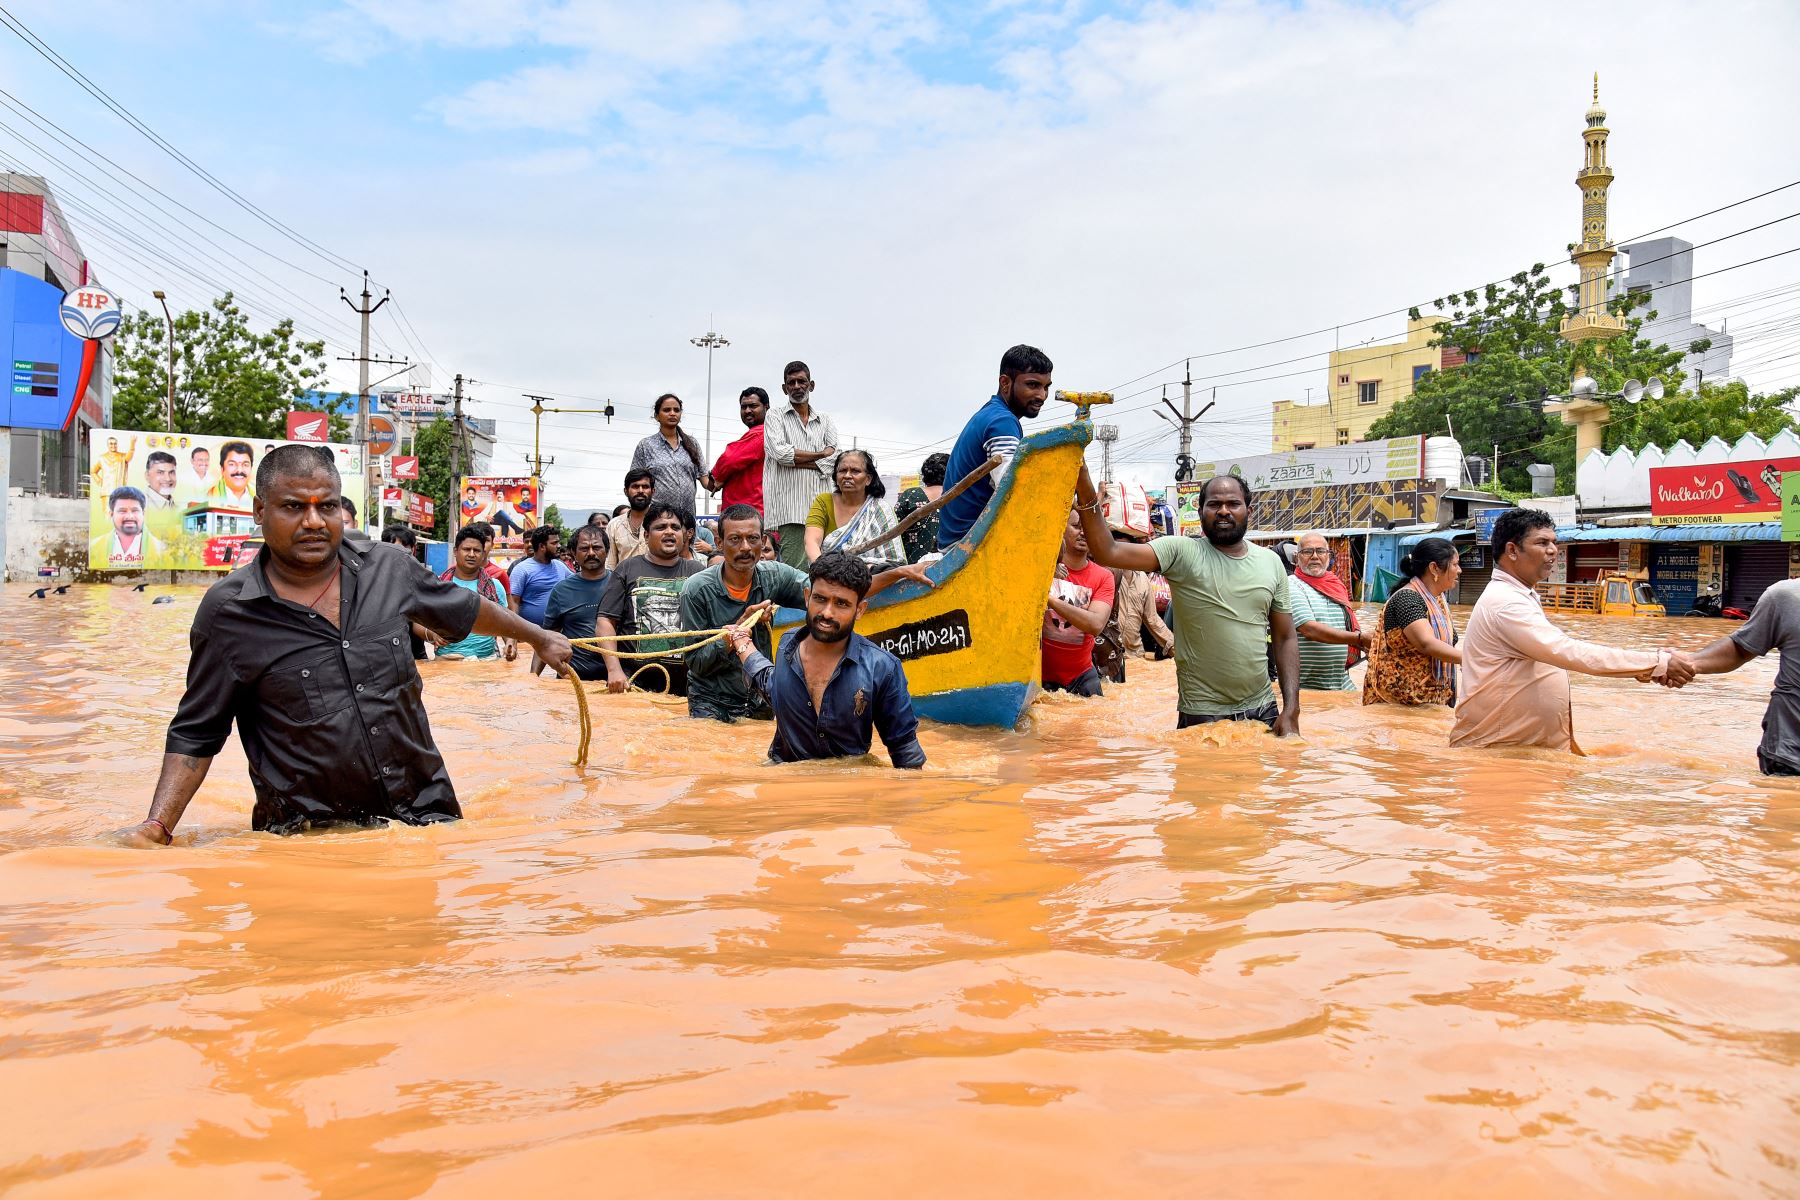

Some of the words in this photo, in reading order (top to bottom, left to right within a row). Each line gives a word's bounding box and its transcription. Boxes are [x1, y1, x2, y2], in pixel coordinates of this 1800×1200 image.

[77, 292, 109, 309] HP
[401, 394, 432, 404] EAGLE
[1270, 464, 1315, 482] zaara
